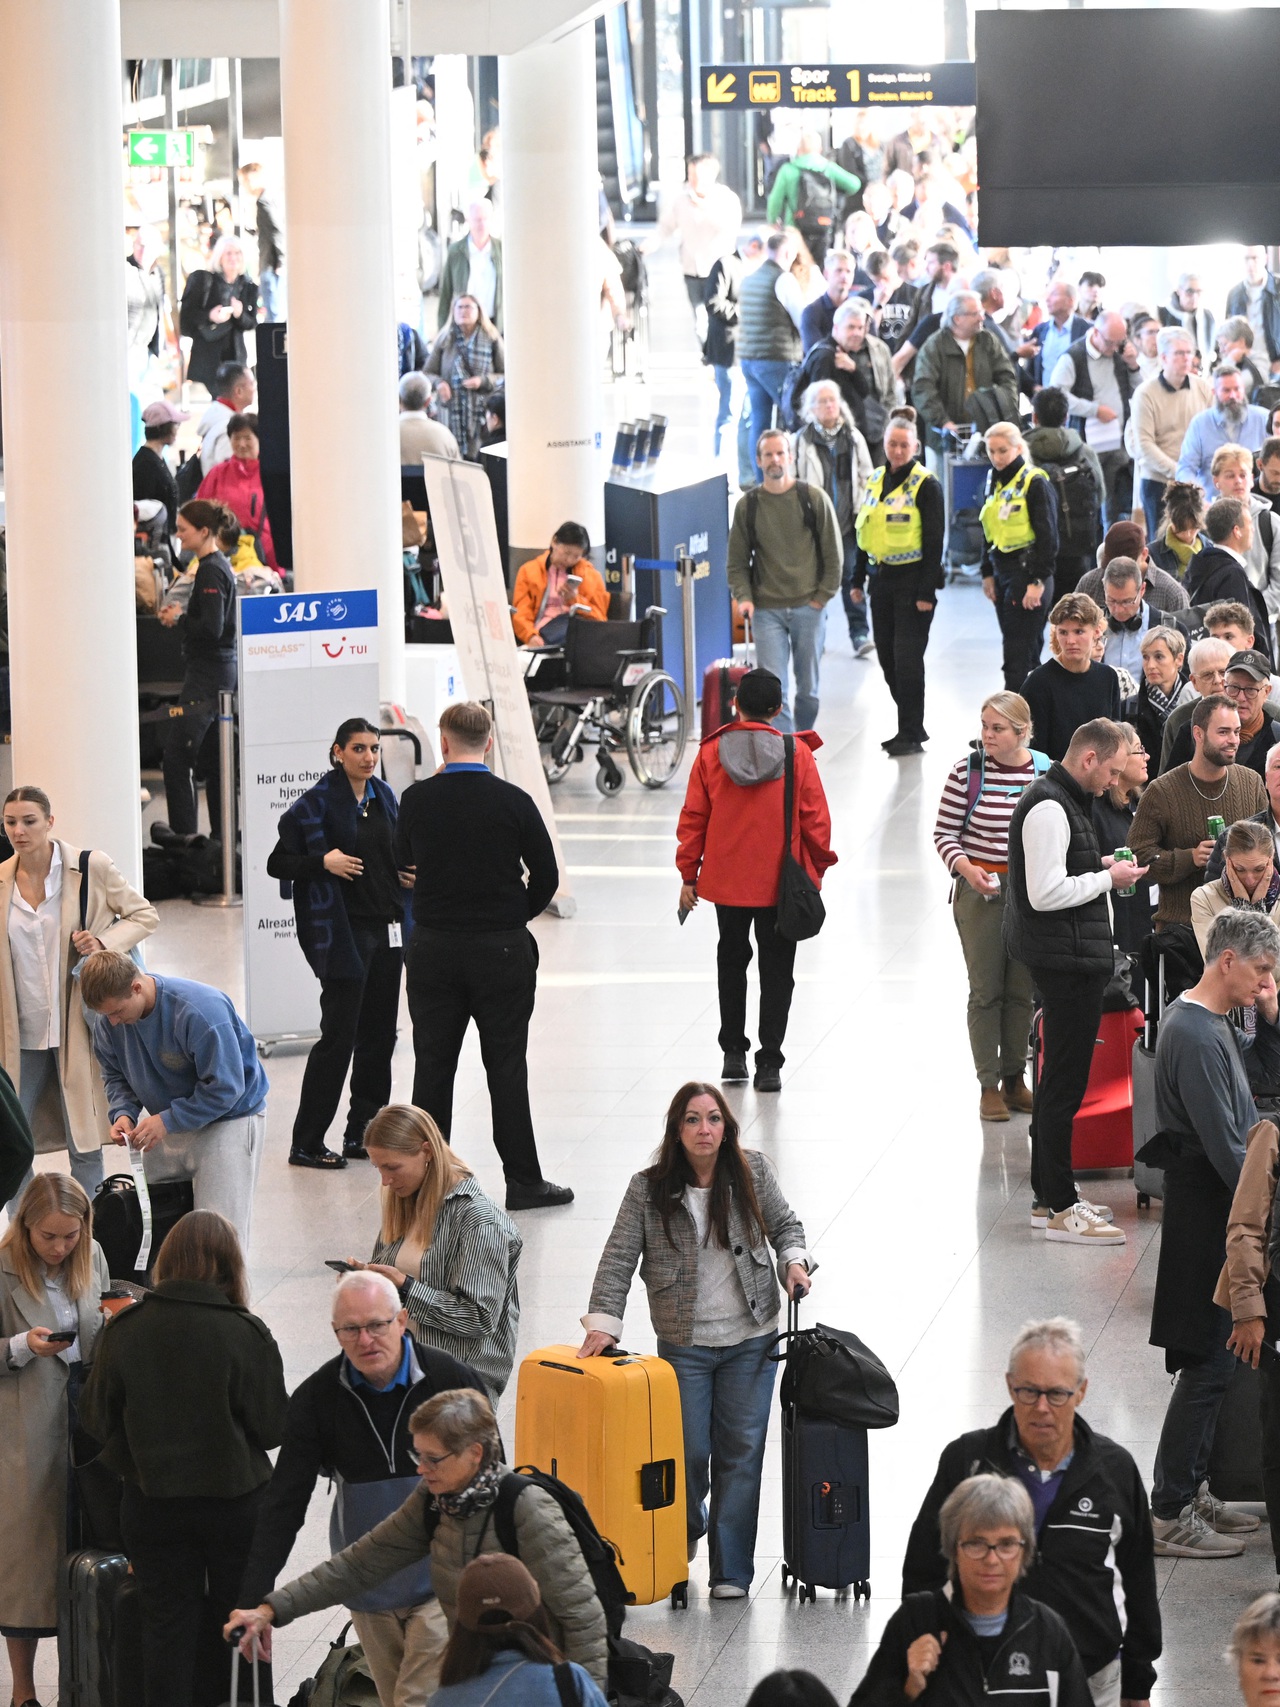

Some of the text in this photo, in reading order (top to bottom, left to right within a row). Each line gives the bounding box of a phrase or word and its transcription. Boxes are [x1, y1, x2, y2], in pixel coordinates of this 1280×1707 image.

[791, 67, 860, 102] Spor 1
[791, 85, 836, 103] Track
[274, 601, 322, 623] SAS
[248, 644, 299, 656] SUNCLASS
[349, 645, 367, 655] TUI
[257, 774, 277, 785] Har
[280, 771, 295, 783] du
[279, 787, 307, 800] hjem
[270, 801, 288, 809] Print
[258, 917, 294, 930] Alread
[274, 931, 292, 939] Print
